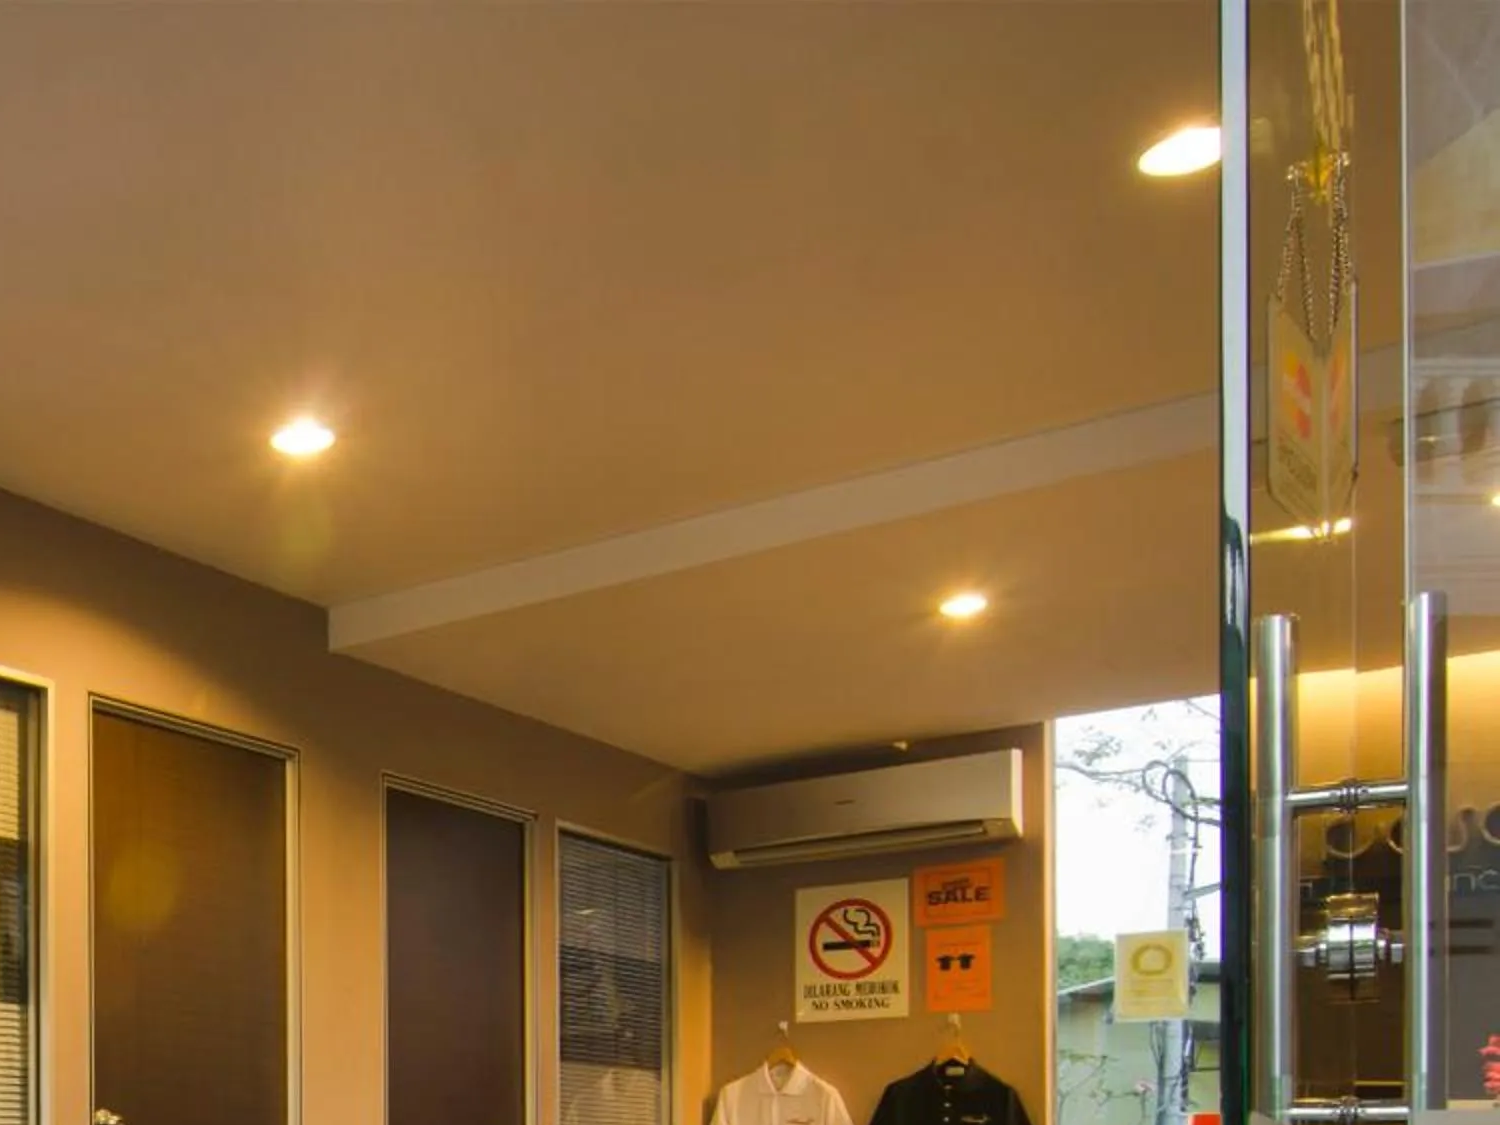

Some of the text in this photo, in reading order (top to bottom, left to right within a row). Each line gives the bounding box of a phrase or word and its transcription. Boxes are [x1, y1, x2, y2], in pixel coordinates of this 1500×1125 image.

[926, 884, 992, 906] SALE
[811, 996, 890, 1011] NO SMOKING
